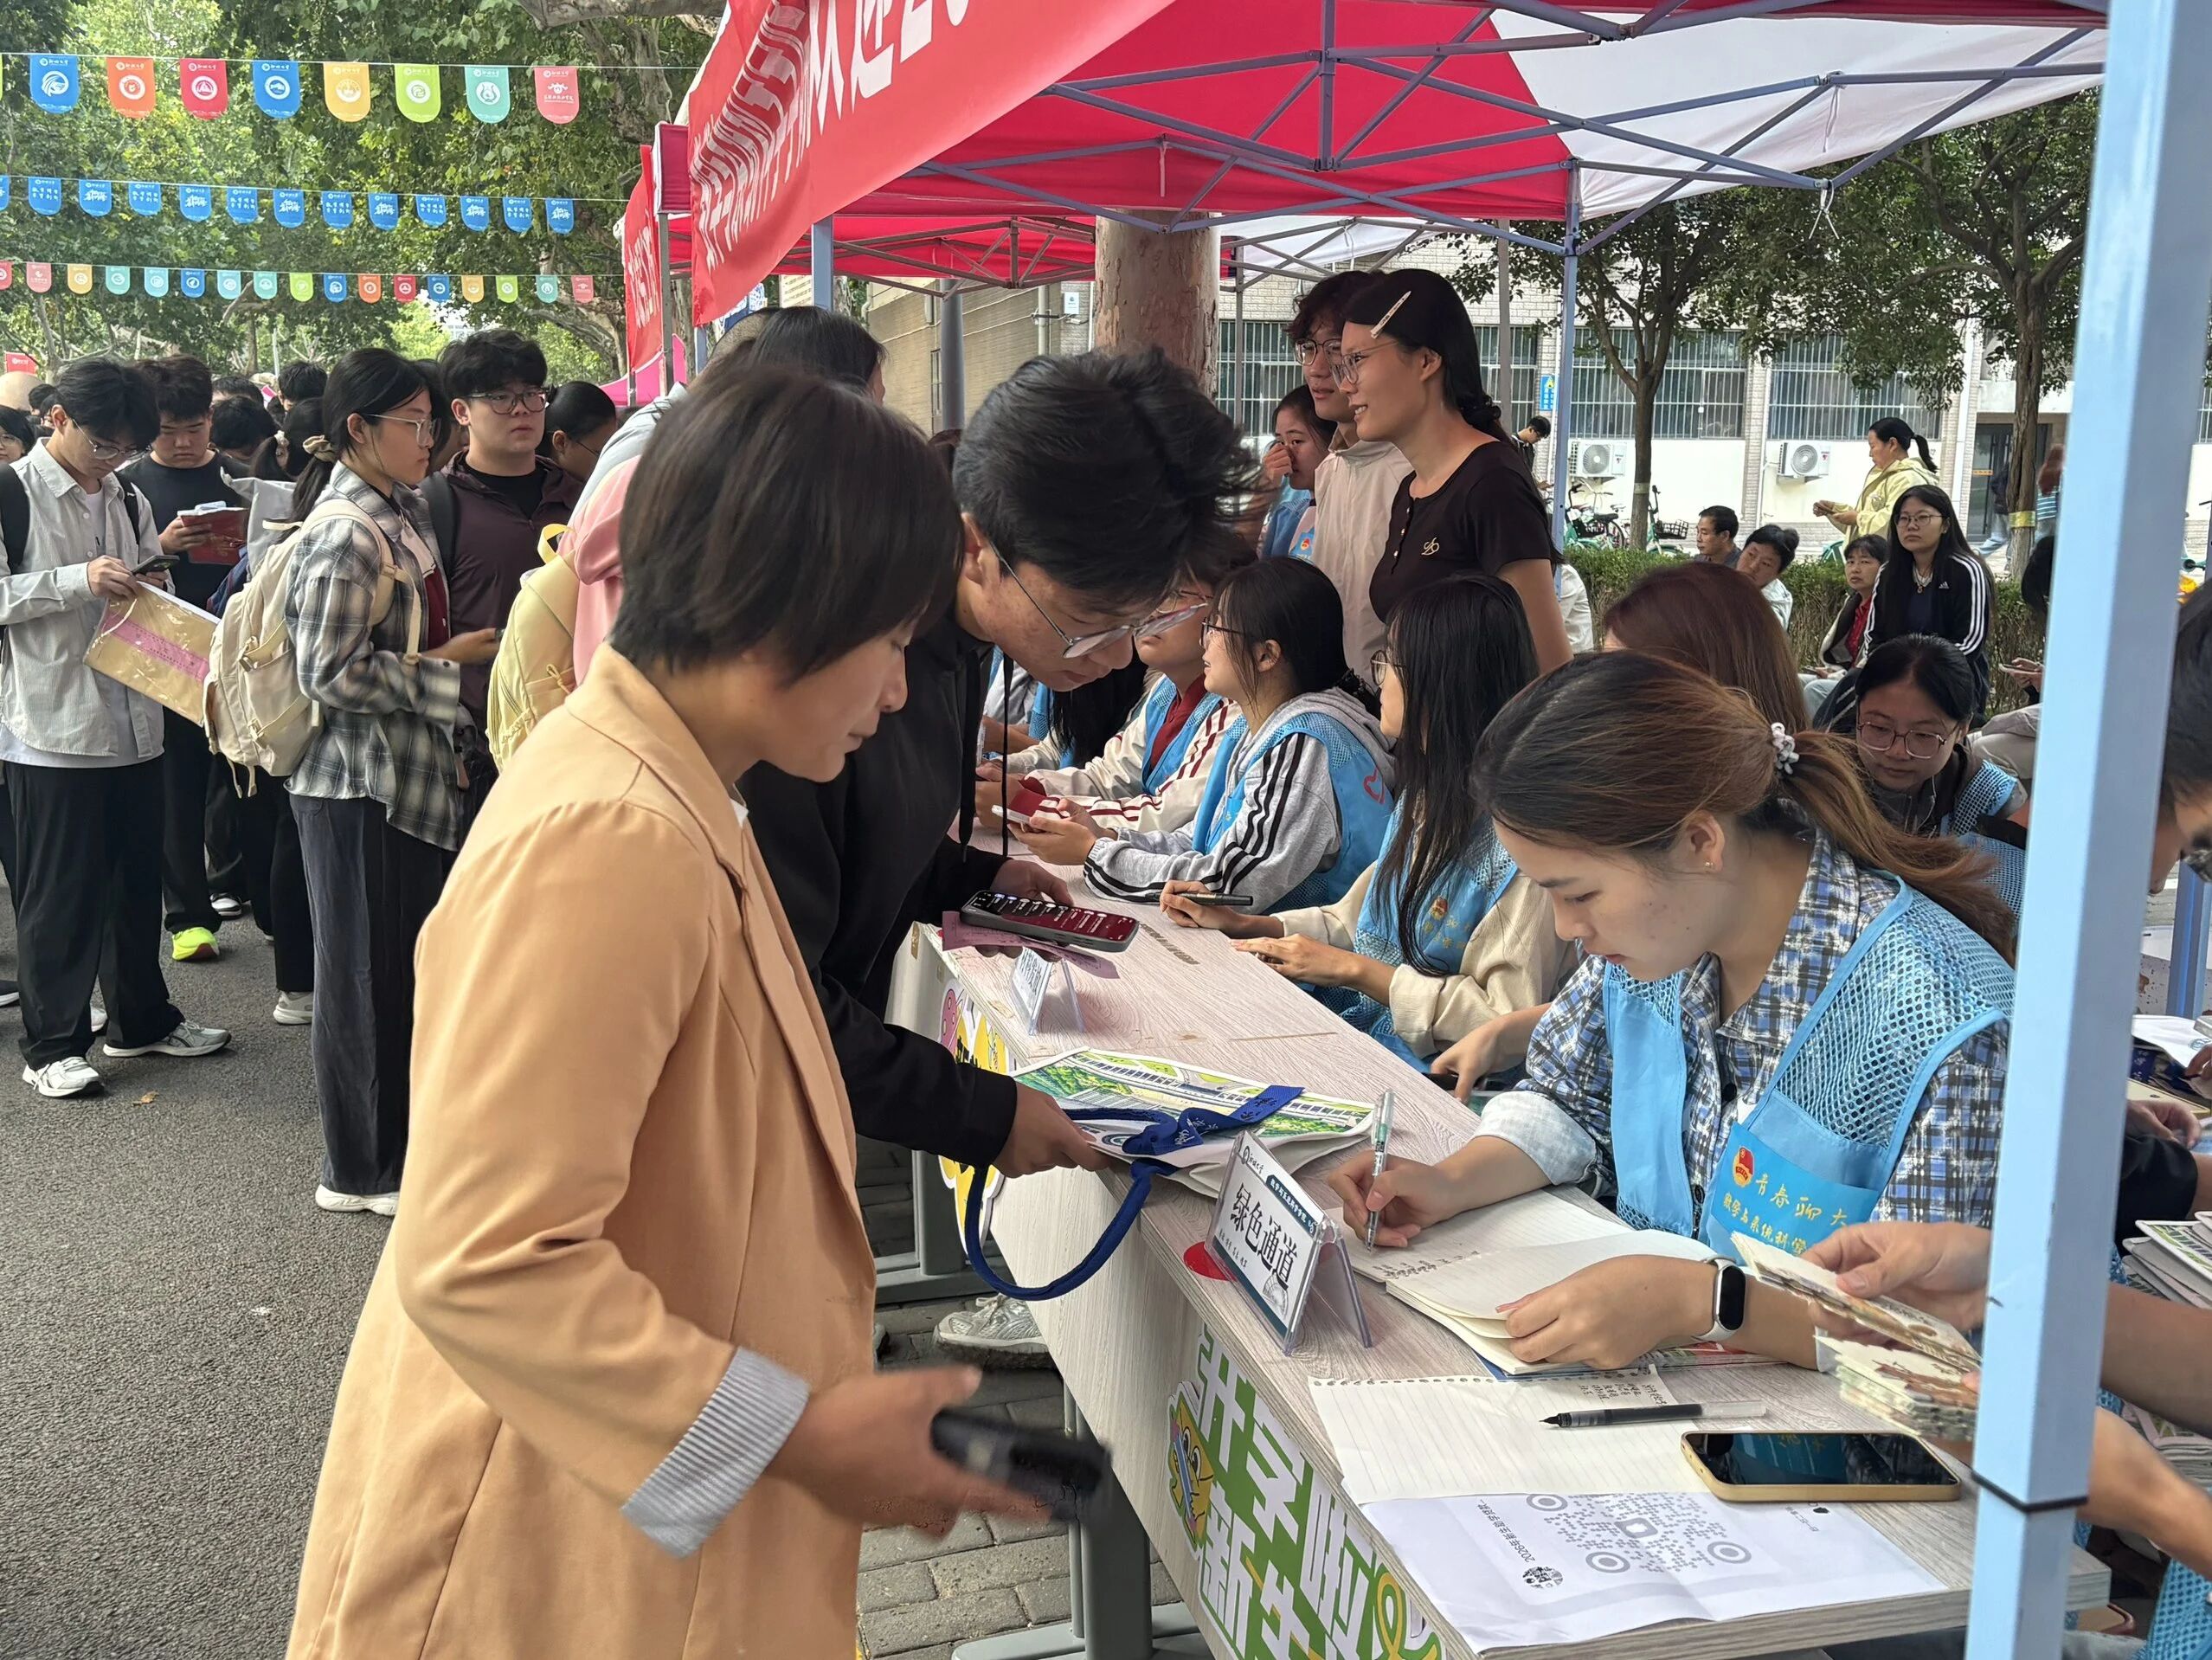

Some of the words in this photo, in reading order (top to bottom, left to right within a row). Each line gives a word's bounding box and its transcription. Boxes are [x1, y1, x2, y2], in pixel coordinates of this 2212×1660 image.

[1231, 1182, 1298, 1291] 绿色通道
[1755, 1173, 1849, 1226] 青春聊大
